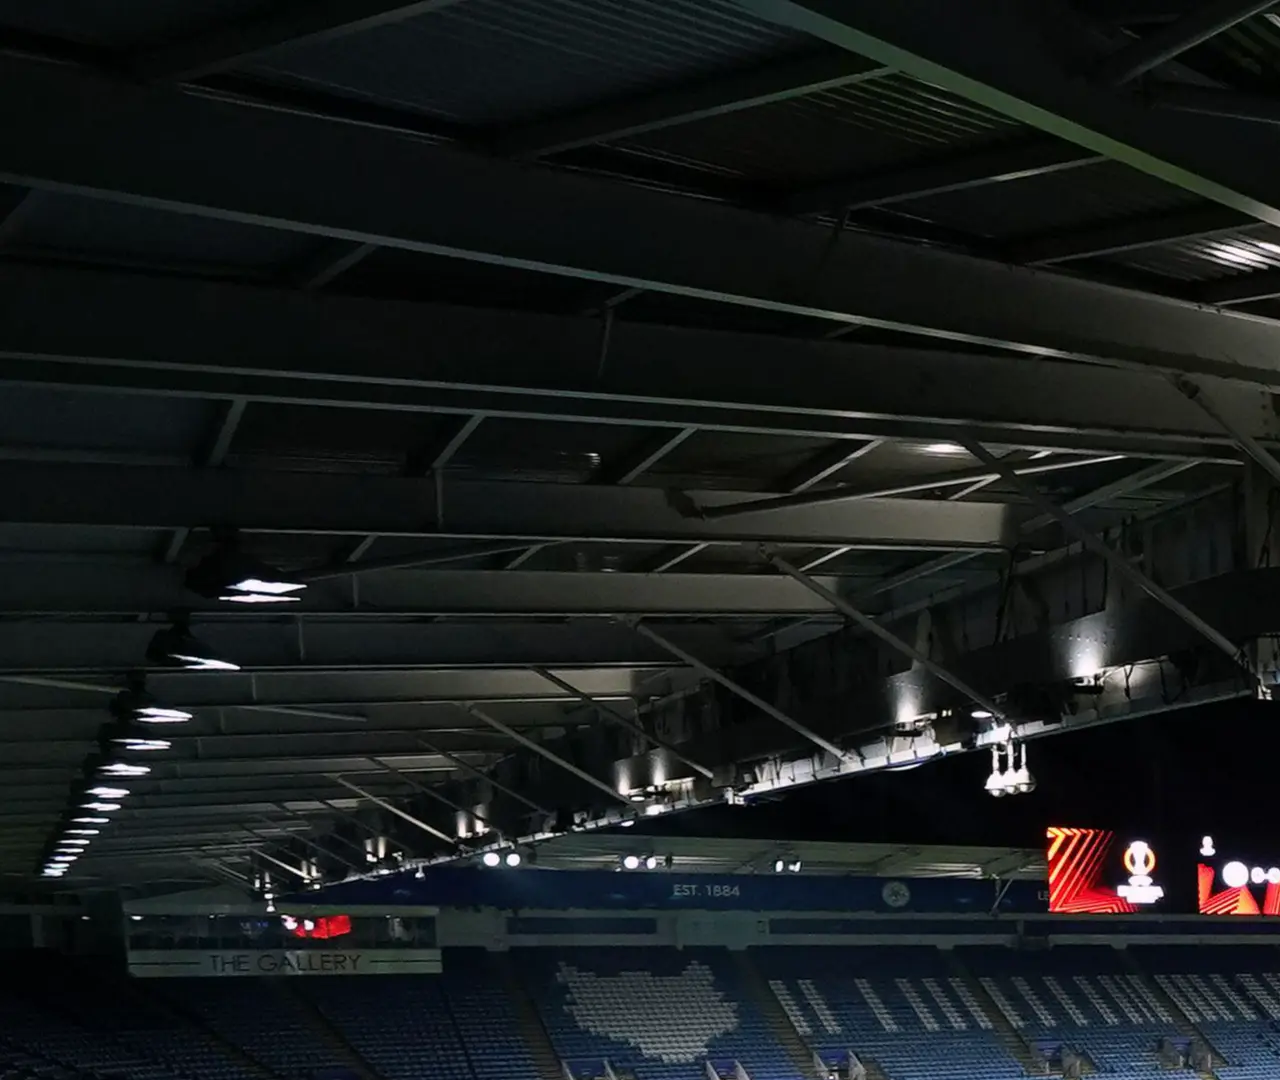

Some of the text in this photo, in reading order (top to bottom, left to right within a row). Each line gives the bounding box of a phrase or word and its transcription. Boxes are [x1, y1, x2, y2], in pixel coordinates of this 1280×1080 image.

[673, 884, 740, 897] EST. 1884
[209, 953, 362, 972] THE GALLERY
